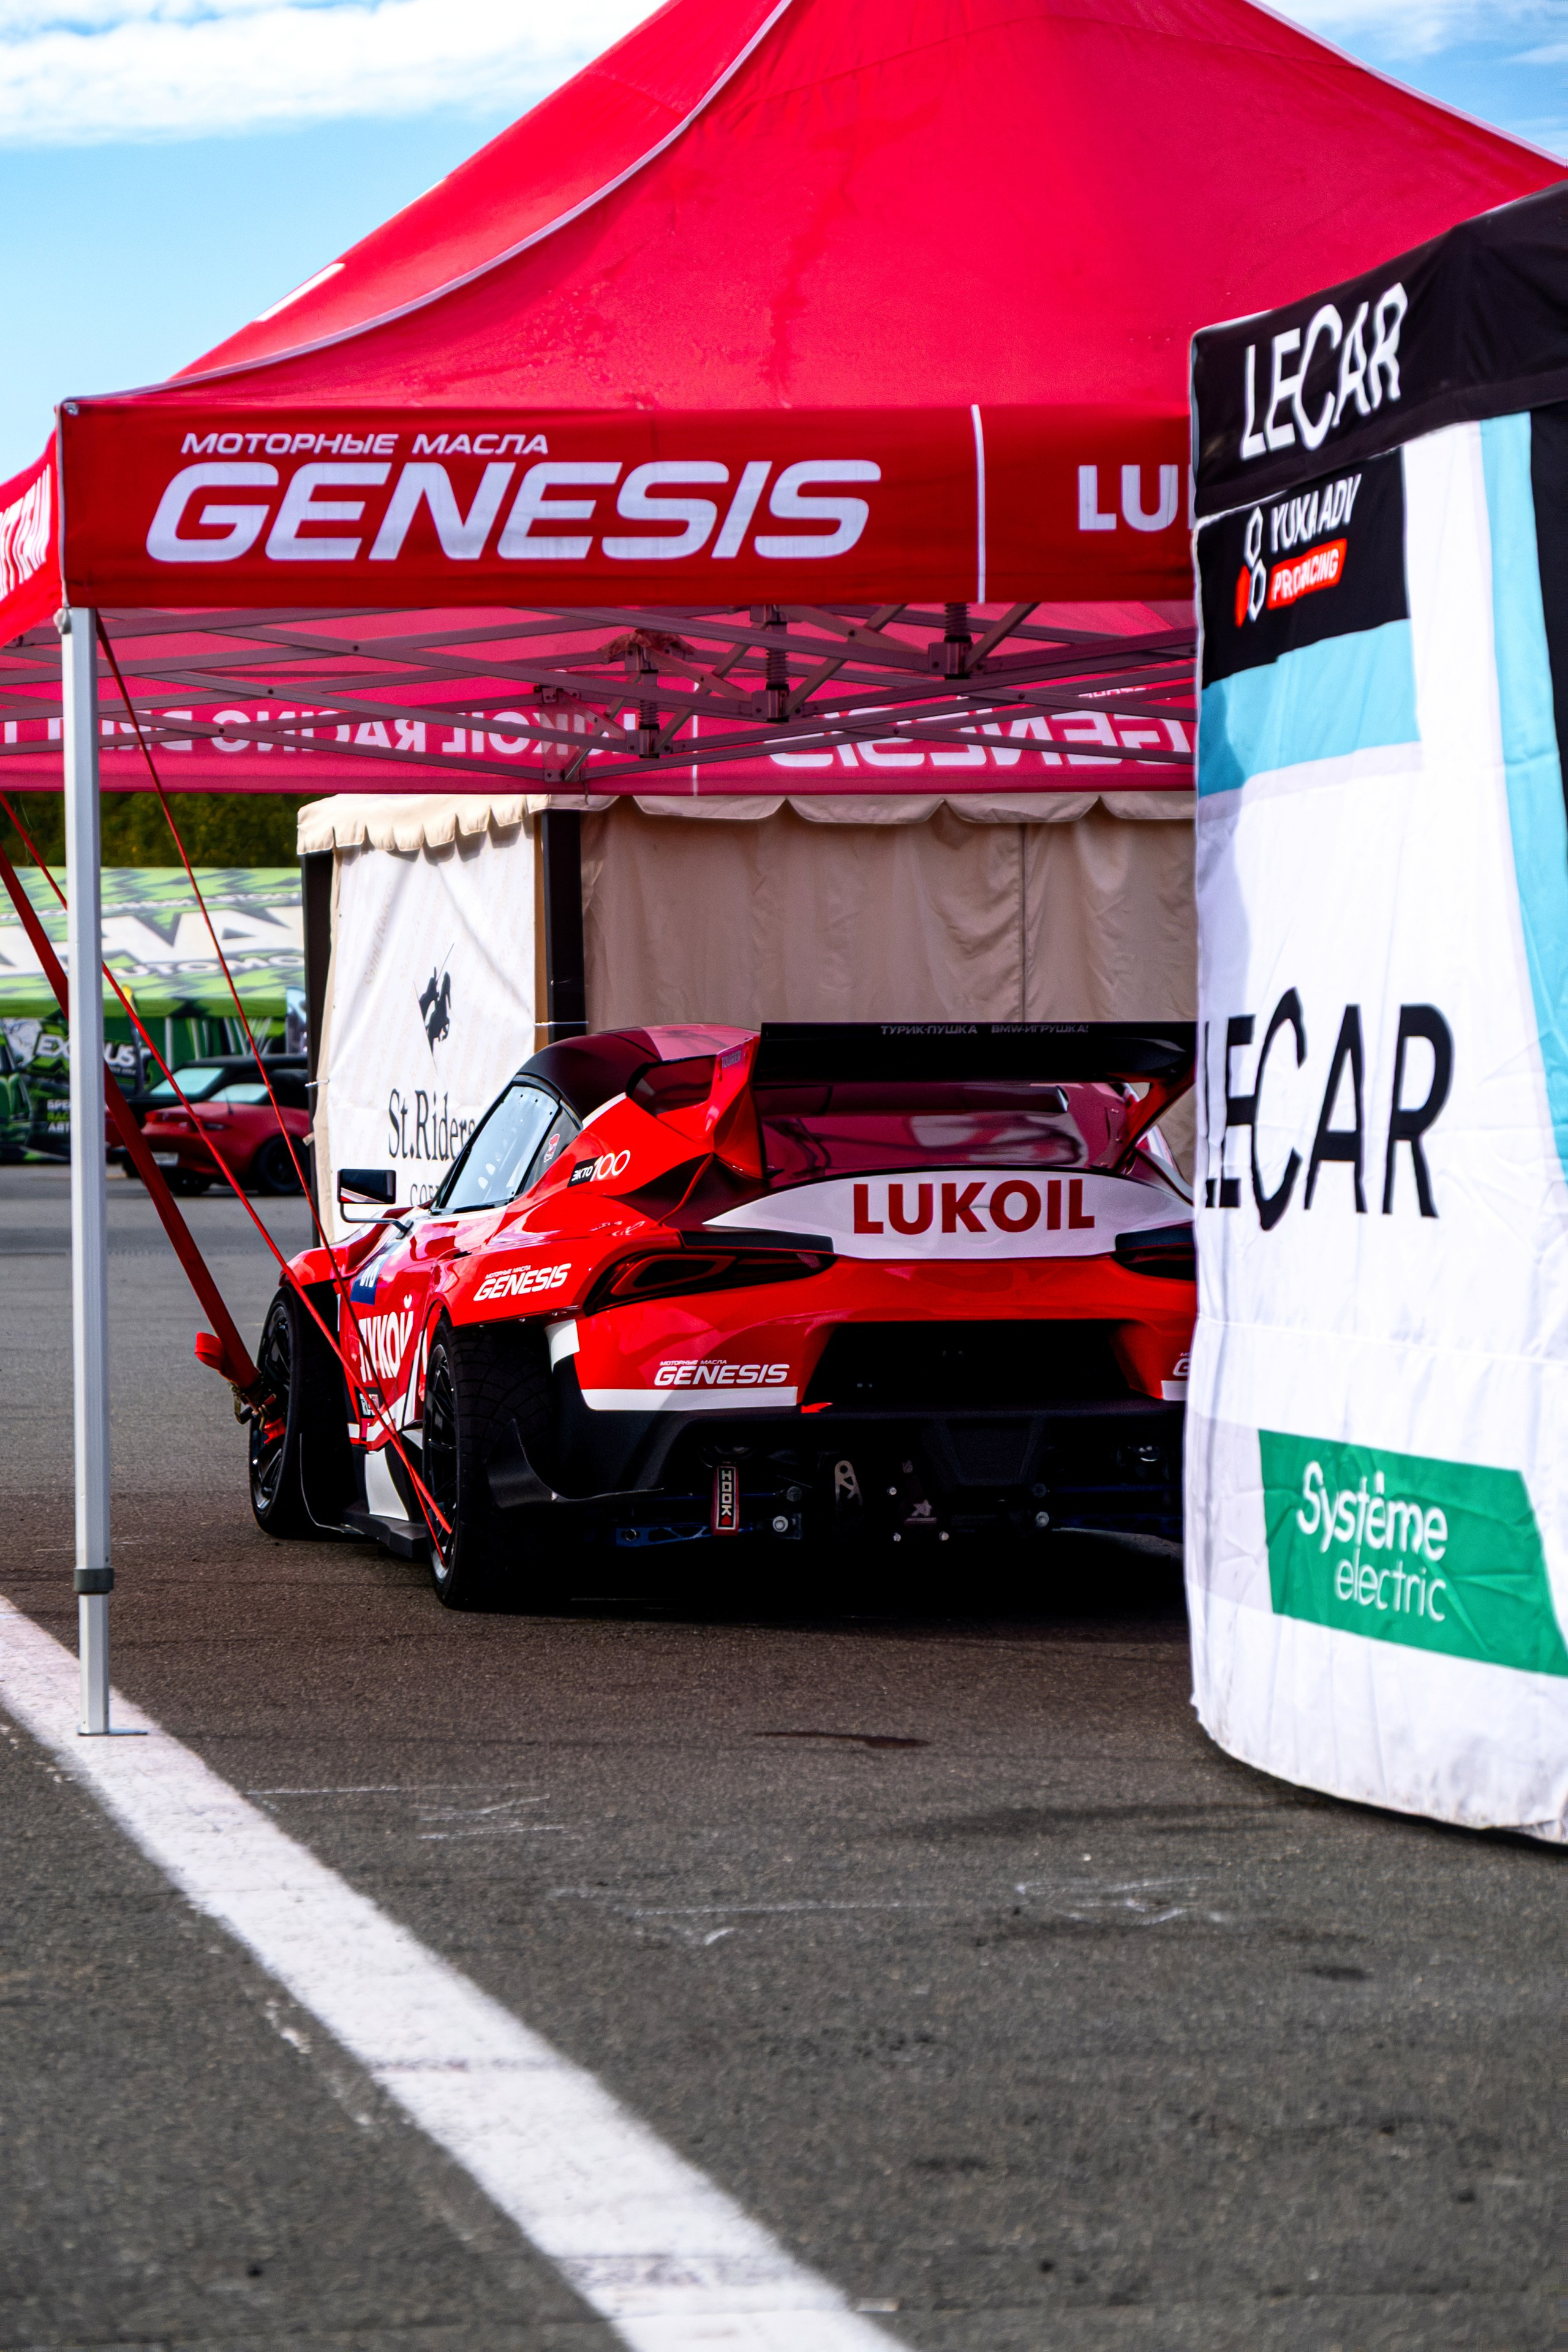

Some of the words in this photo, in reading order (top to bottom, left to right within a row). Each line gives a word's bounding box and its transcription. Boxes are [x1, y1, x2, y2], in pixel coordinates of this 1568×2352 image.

[1239, 282, 1408, 461] LECAR
[181, 432, 399, 454] МОТОРНЫЕ
[411, 434, 548, 454] МАСЛА
[146, 459, 881, 562] GENESIS
[1077, 464, 1195, 532] LU
[853, 1178, 1095, 1235] LUKOIL
[473, 1263, 572, 1301] GENESIS
[654, 1363, 790, 1386] GENESIS
[1335, 1545, 1447, 1621] electric
